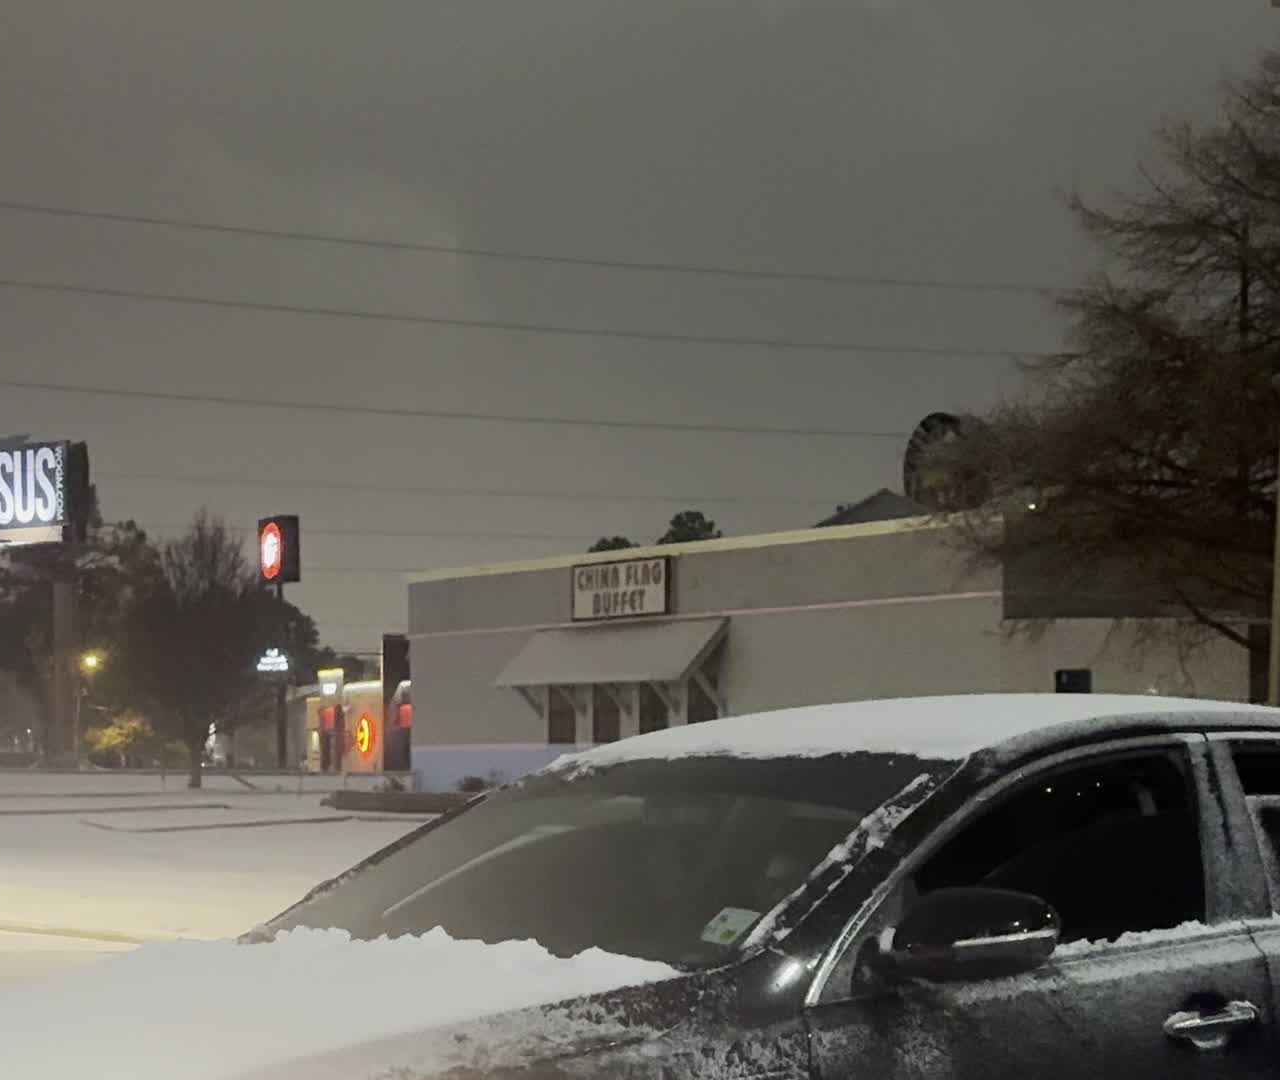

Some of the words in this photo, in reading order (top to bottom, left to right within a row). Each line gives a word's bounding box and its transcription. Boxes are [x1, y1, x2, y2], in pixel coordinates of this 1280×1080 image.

[577, 565, 620, 592] CHINA
[625, 561, 662, 587] FLAG
[592, 588, 646, 616] BUFFET
